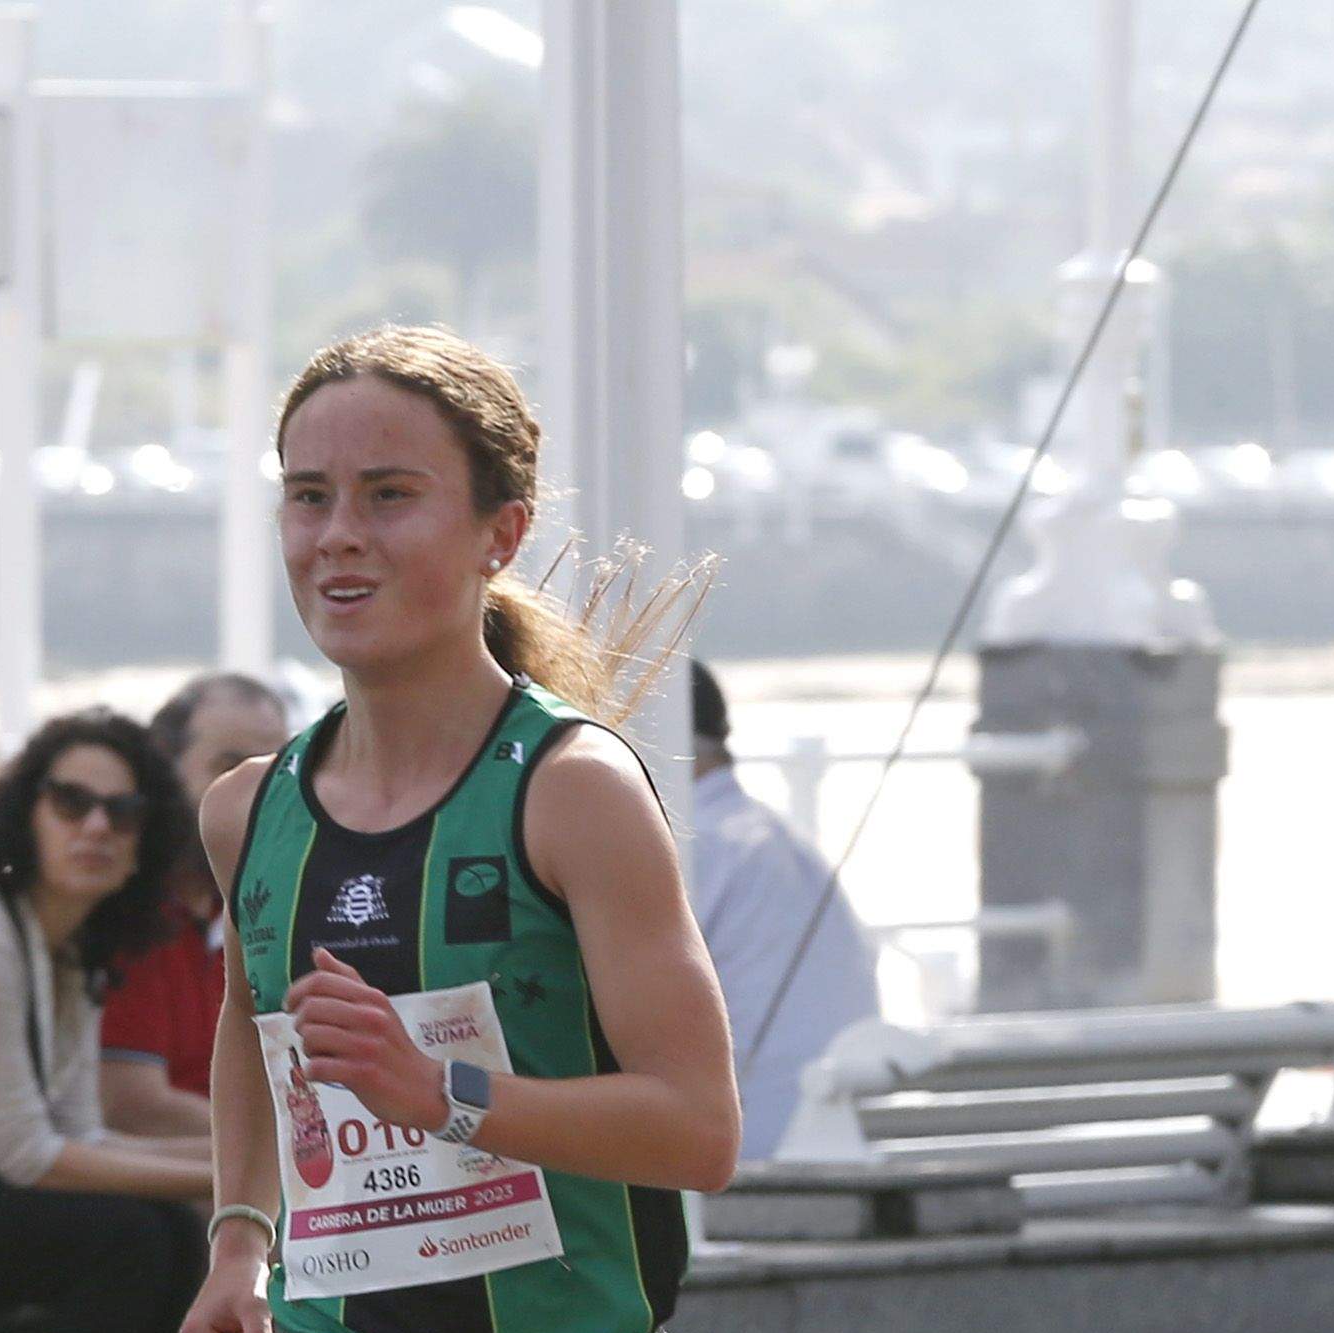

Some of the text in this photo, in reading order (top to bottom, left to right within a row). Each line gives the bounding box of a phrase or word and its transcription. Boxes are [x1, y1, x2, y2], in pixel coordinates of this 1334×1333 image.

[424, 1024, 480, 1047] SUMA
[364, 1164, 421, 1192] 4386
[367, 1206, 390, 1223] DE
[394, 1204, 415, 1219] LA
[418, 1195, 467, 1216] MUJER
[474, 1184, 514, 1206] 2023
[439, 1222, 532, 1256] Santander
